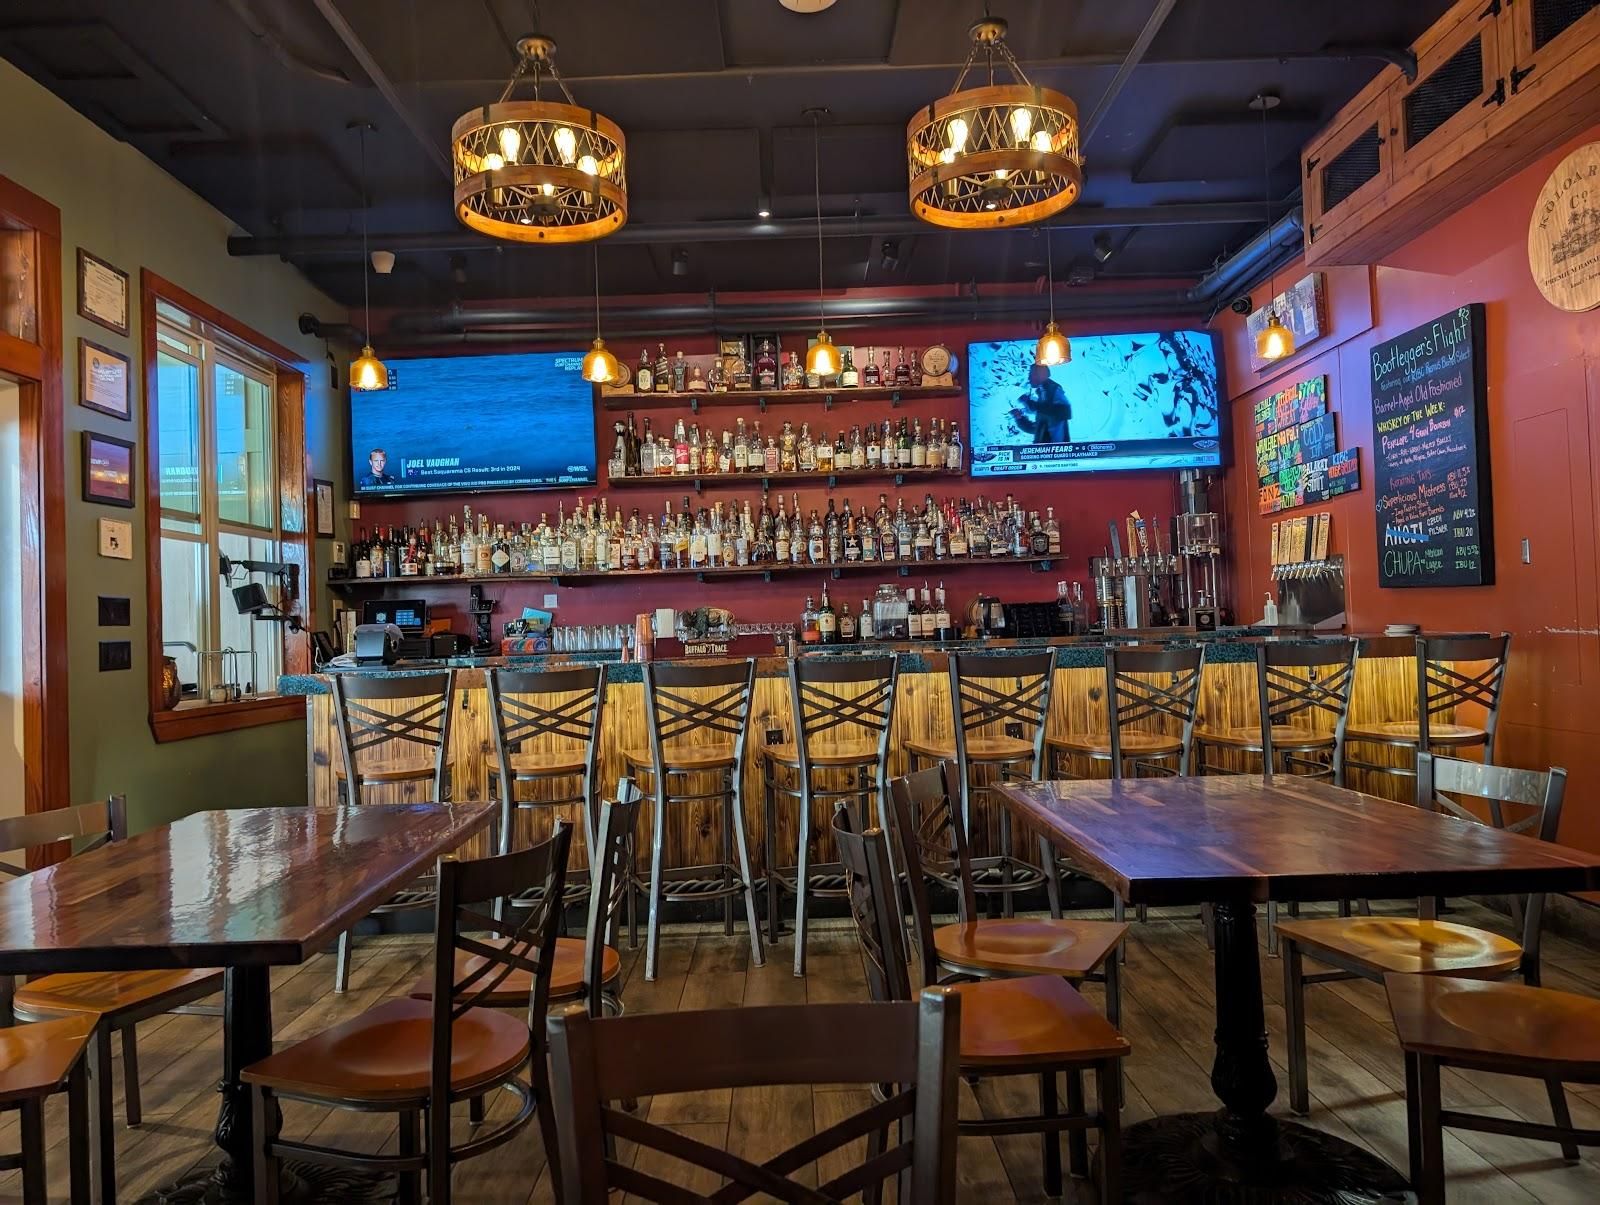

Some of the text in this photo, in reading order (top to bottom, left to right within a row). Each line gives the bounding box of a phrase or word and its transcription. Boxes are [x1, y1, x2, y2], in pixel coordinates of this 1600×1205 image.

[1372, 319, 1468, 381] Bootlegger's Flight
[1428, 371, 1463, 397] Fashioned
[1377, 415, 1402, 433] WHISKEY
[1403, 414, 1411, 425] OF
[1411, 409, 1423, 422] THE
[1051, 445, 1073, 453] FEARS
[406, 457, 460, 468] JOEL VAUGHAN
[1465, 526, 1474, 537] 20
[711, 643, 729, 654] TRACE
